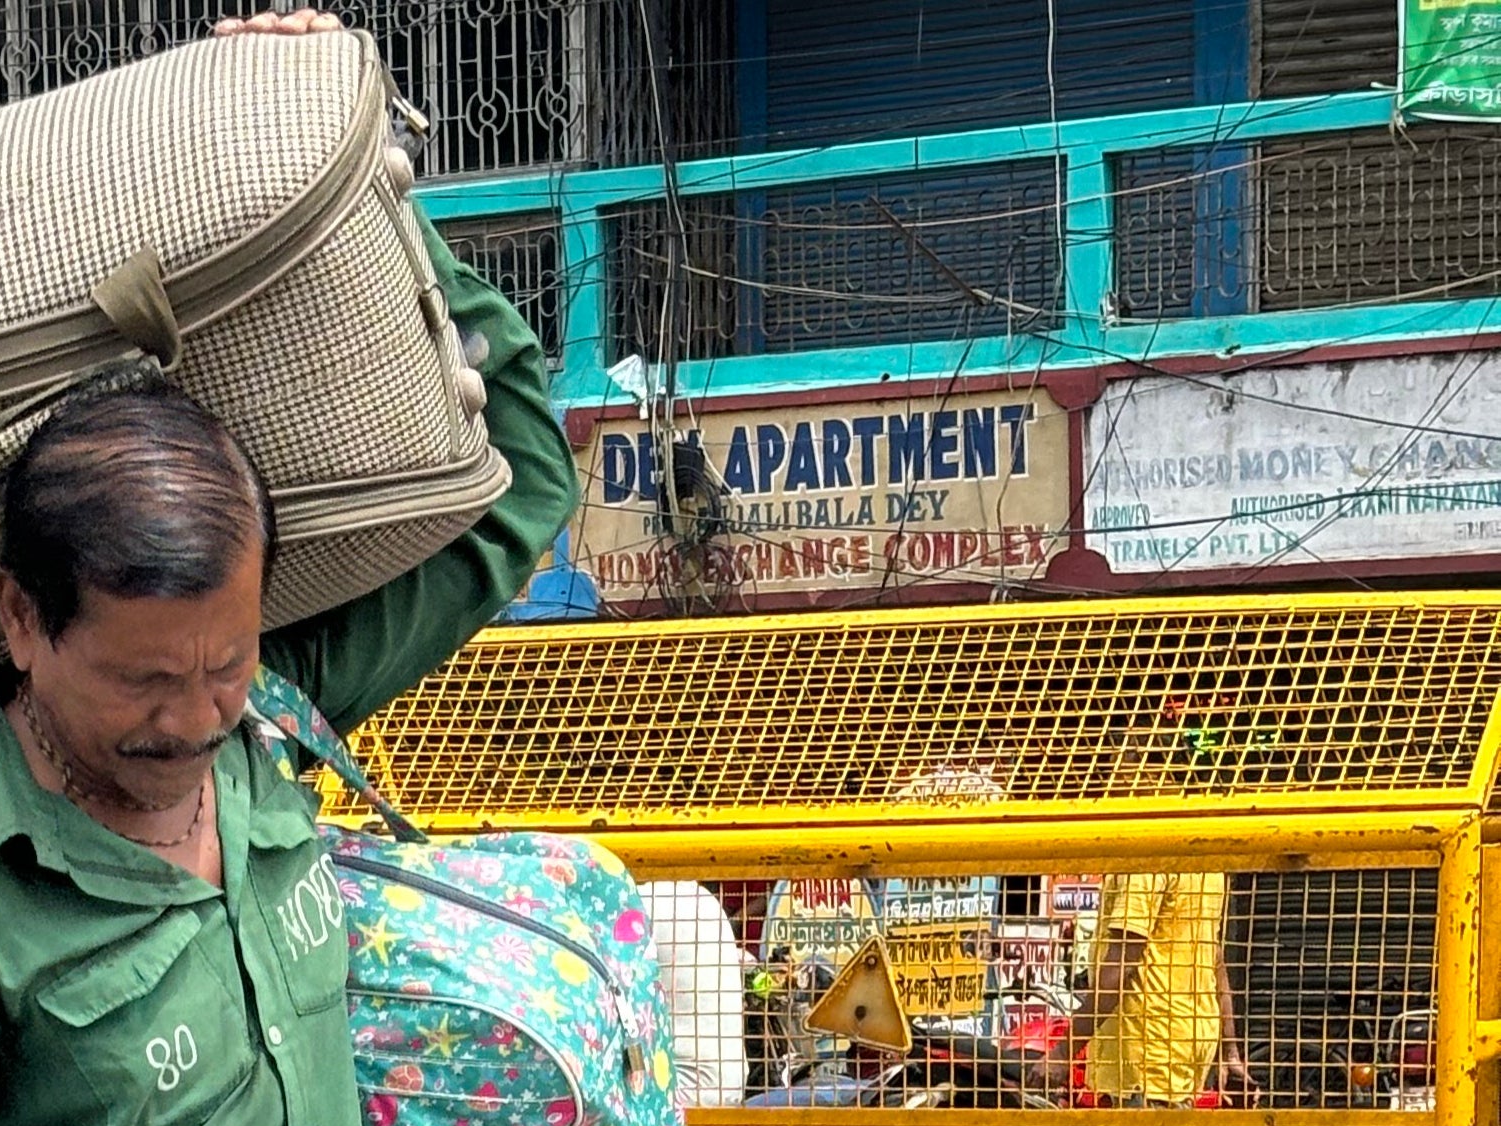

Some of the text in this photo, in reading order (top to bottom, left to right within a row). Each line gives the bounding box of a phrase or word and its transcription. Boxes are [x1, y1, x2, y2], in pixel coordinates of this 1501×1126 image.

[722, 401, 1038, 498] APARTMENT
[1239, 444, 1359, 481] MONEY
[887, 489, 950, 522] DEY
[1230, 492, 1326, 526] AUTHORISED
[884, 522, 1049, 573] COMPLEX
[1110, 536, 1199, 562] TRAVELS
[146, 1024, 196, 1090] 80
